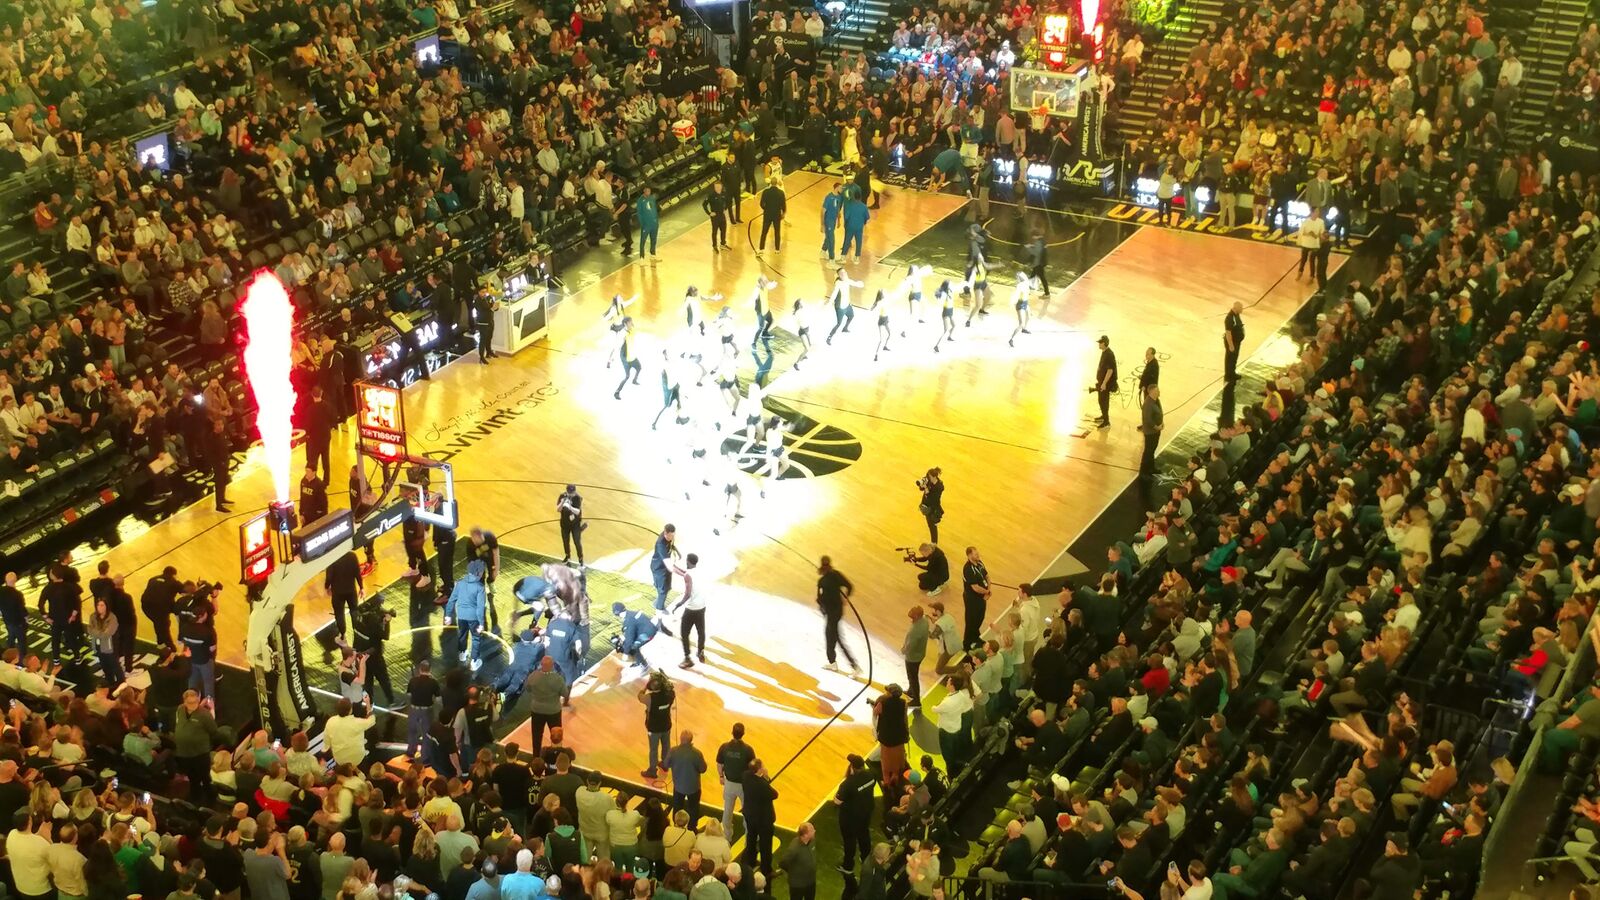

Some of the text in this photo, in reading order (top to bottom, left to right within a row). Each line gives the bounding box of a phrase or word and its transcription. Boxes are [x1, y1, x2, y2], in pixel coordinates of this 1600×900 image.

[372, 430, 401, 443] TISSOT
[286, 632, 309, 710] AMERICA FIRST
